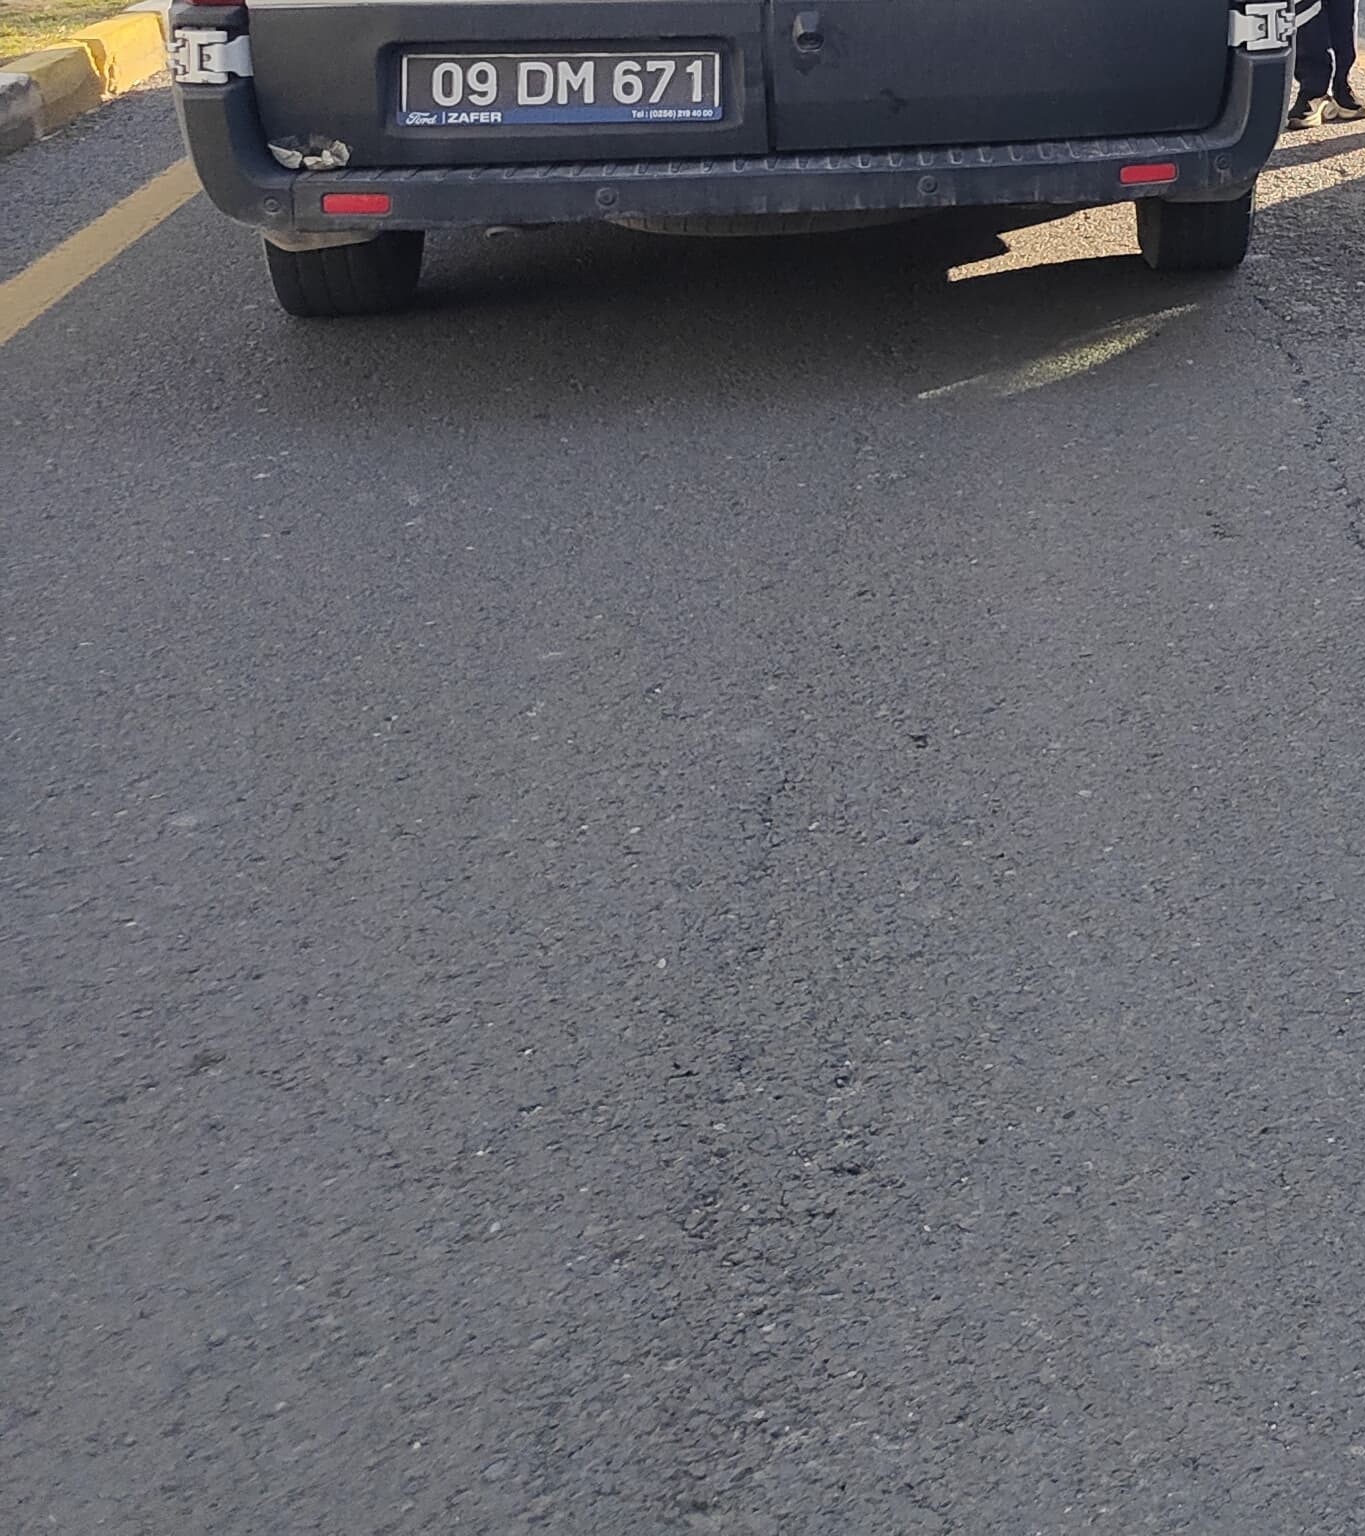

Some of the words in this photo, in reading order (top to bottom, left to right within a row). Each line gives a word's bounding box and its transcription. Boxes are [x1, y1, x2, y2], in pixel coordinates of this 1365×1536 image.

[431, 61, 498, 107] 09
[517, 61, 595, 105] DM
[612, 59, 703, 106] 671
[447, 111, 502, 124] ZAFER
